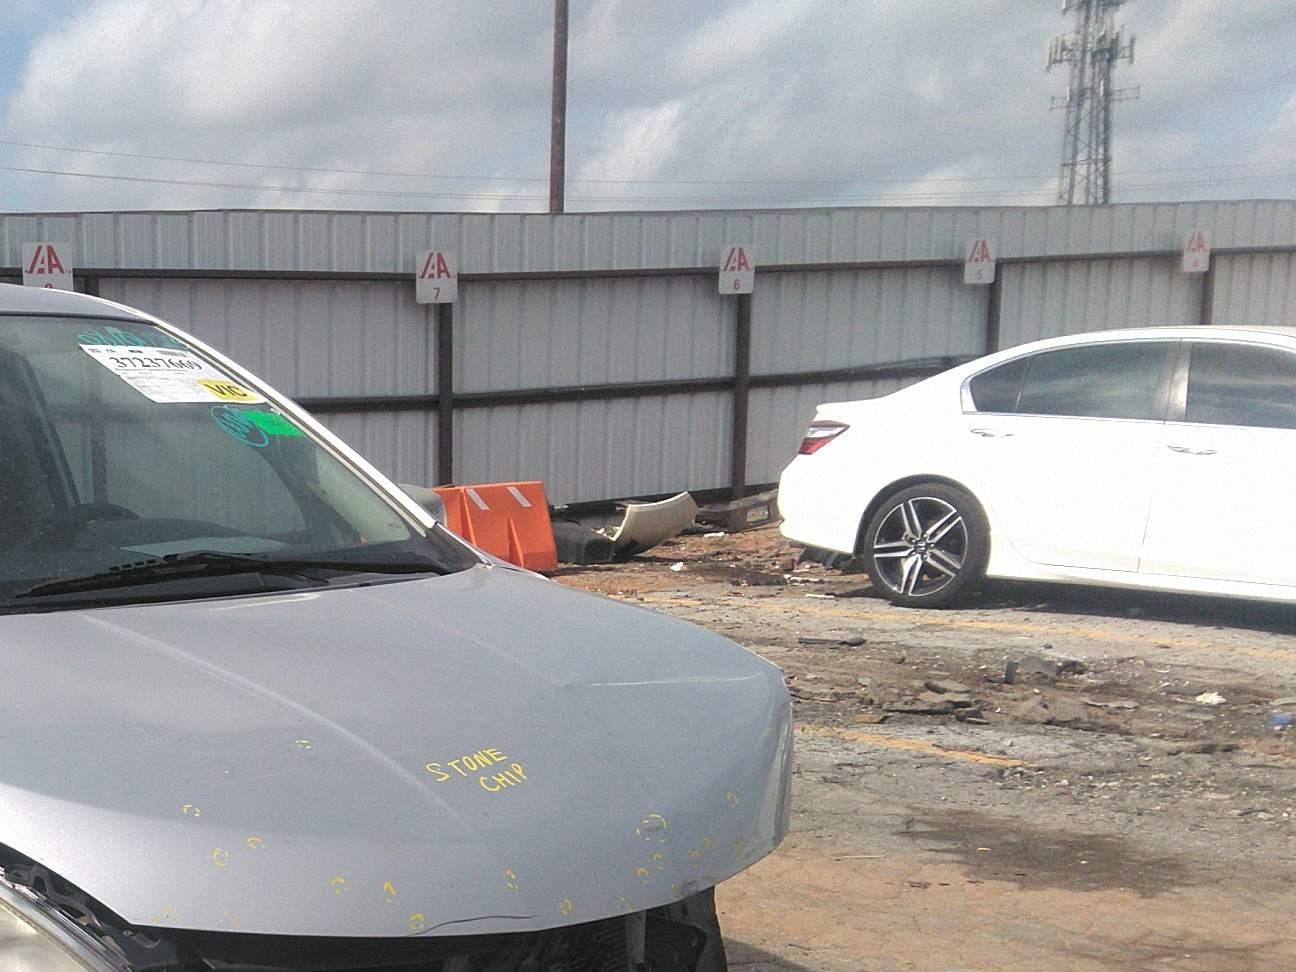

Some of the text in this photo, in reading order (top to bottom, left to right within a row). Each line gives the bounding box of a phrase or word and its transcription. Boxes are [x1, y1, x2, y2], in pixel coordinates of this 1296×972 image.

[733, 278, 740, 289] 6
[433, 287, 441, 299] 7
[479, 763, 528, 792] CHIP
